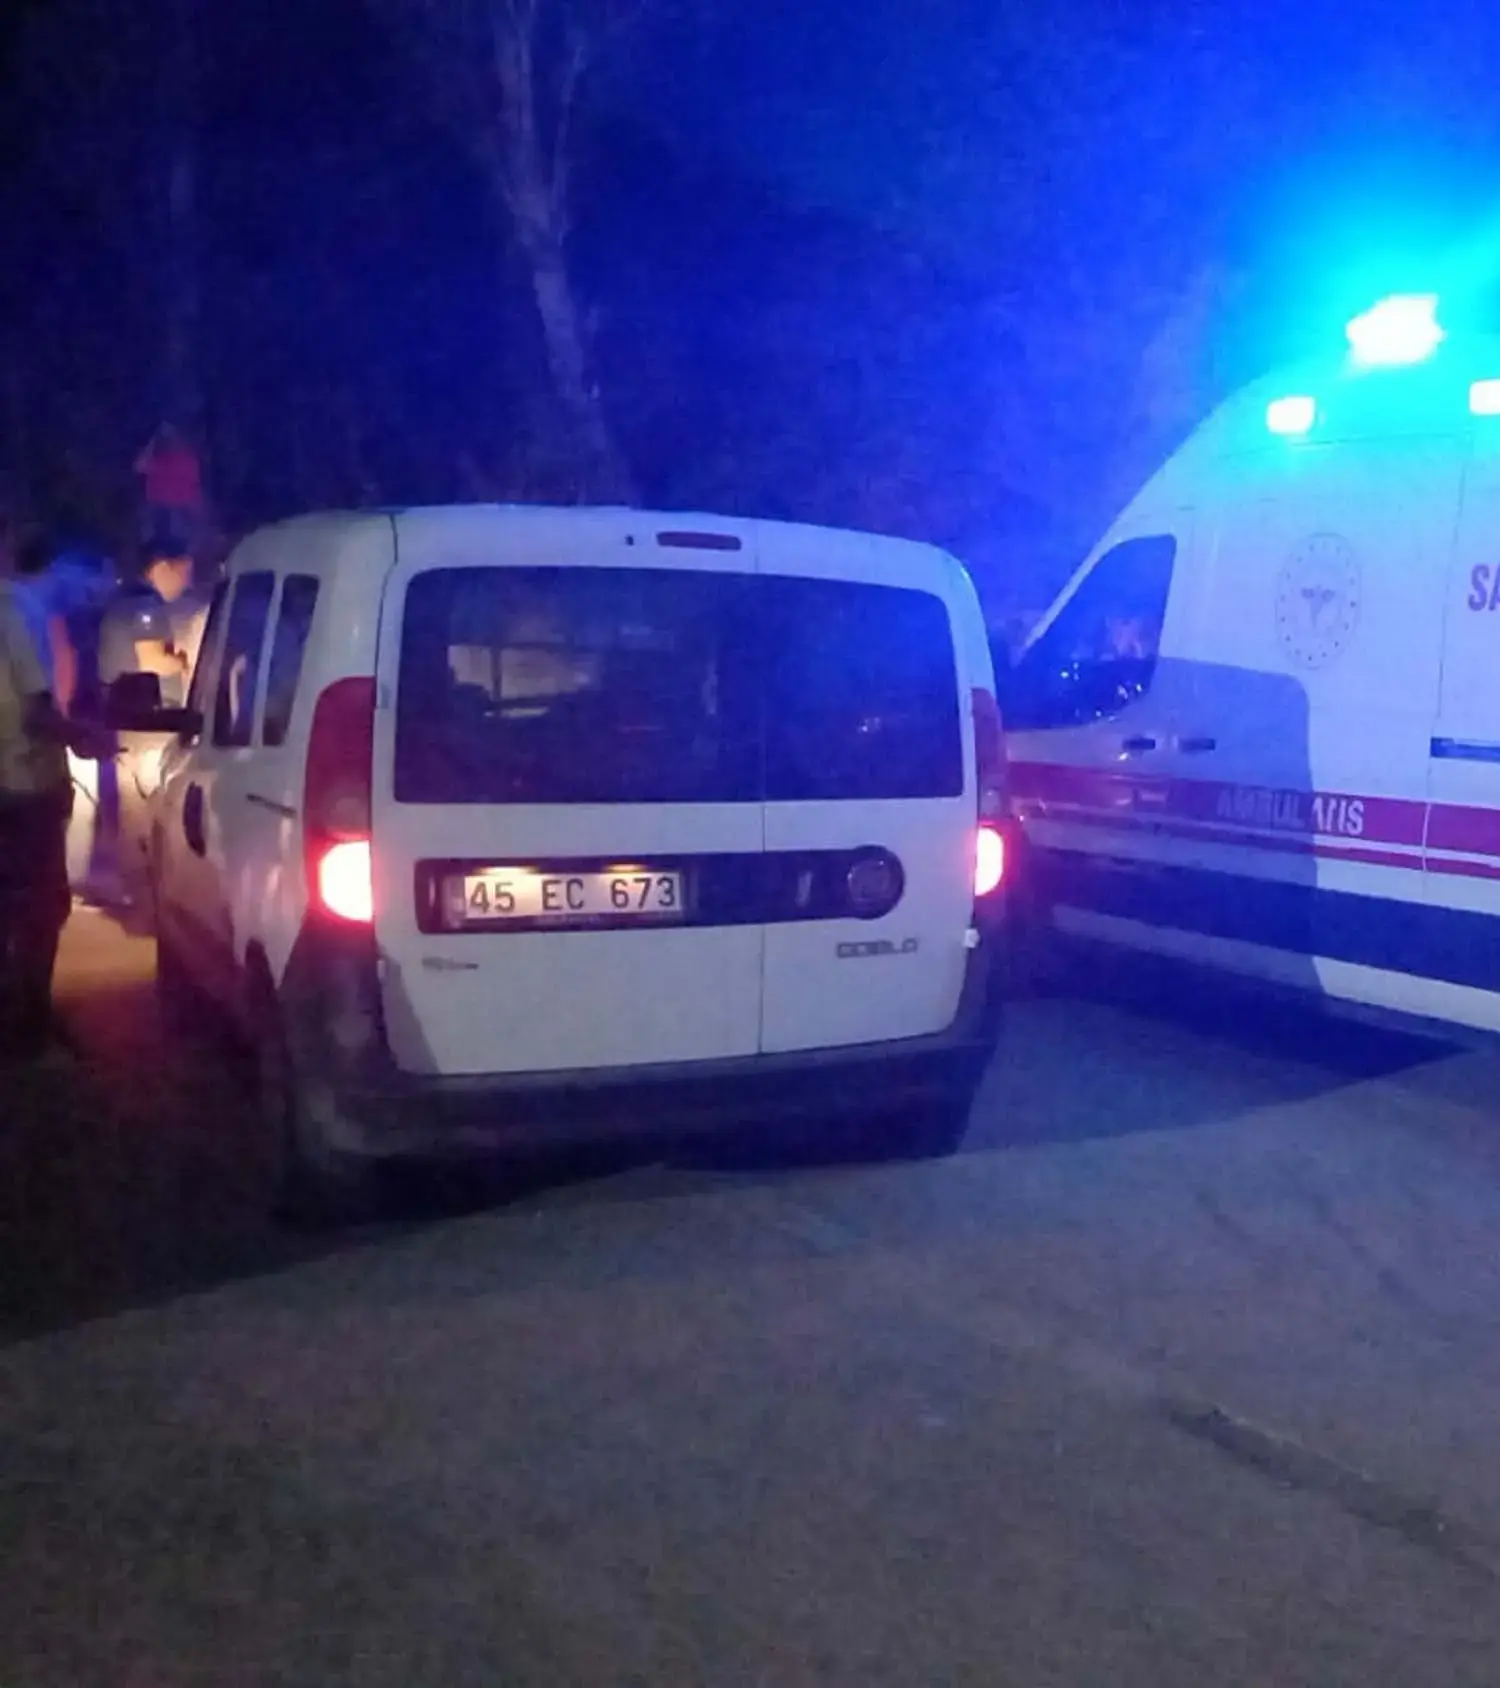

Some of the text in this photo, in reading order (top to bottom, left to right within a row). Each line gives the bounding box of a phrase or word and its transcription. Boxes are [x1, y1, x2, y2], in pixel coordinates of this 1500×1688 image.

[469, 876, 676, 914] 45 EC 673
